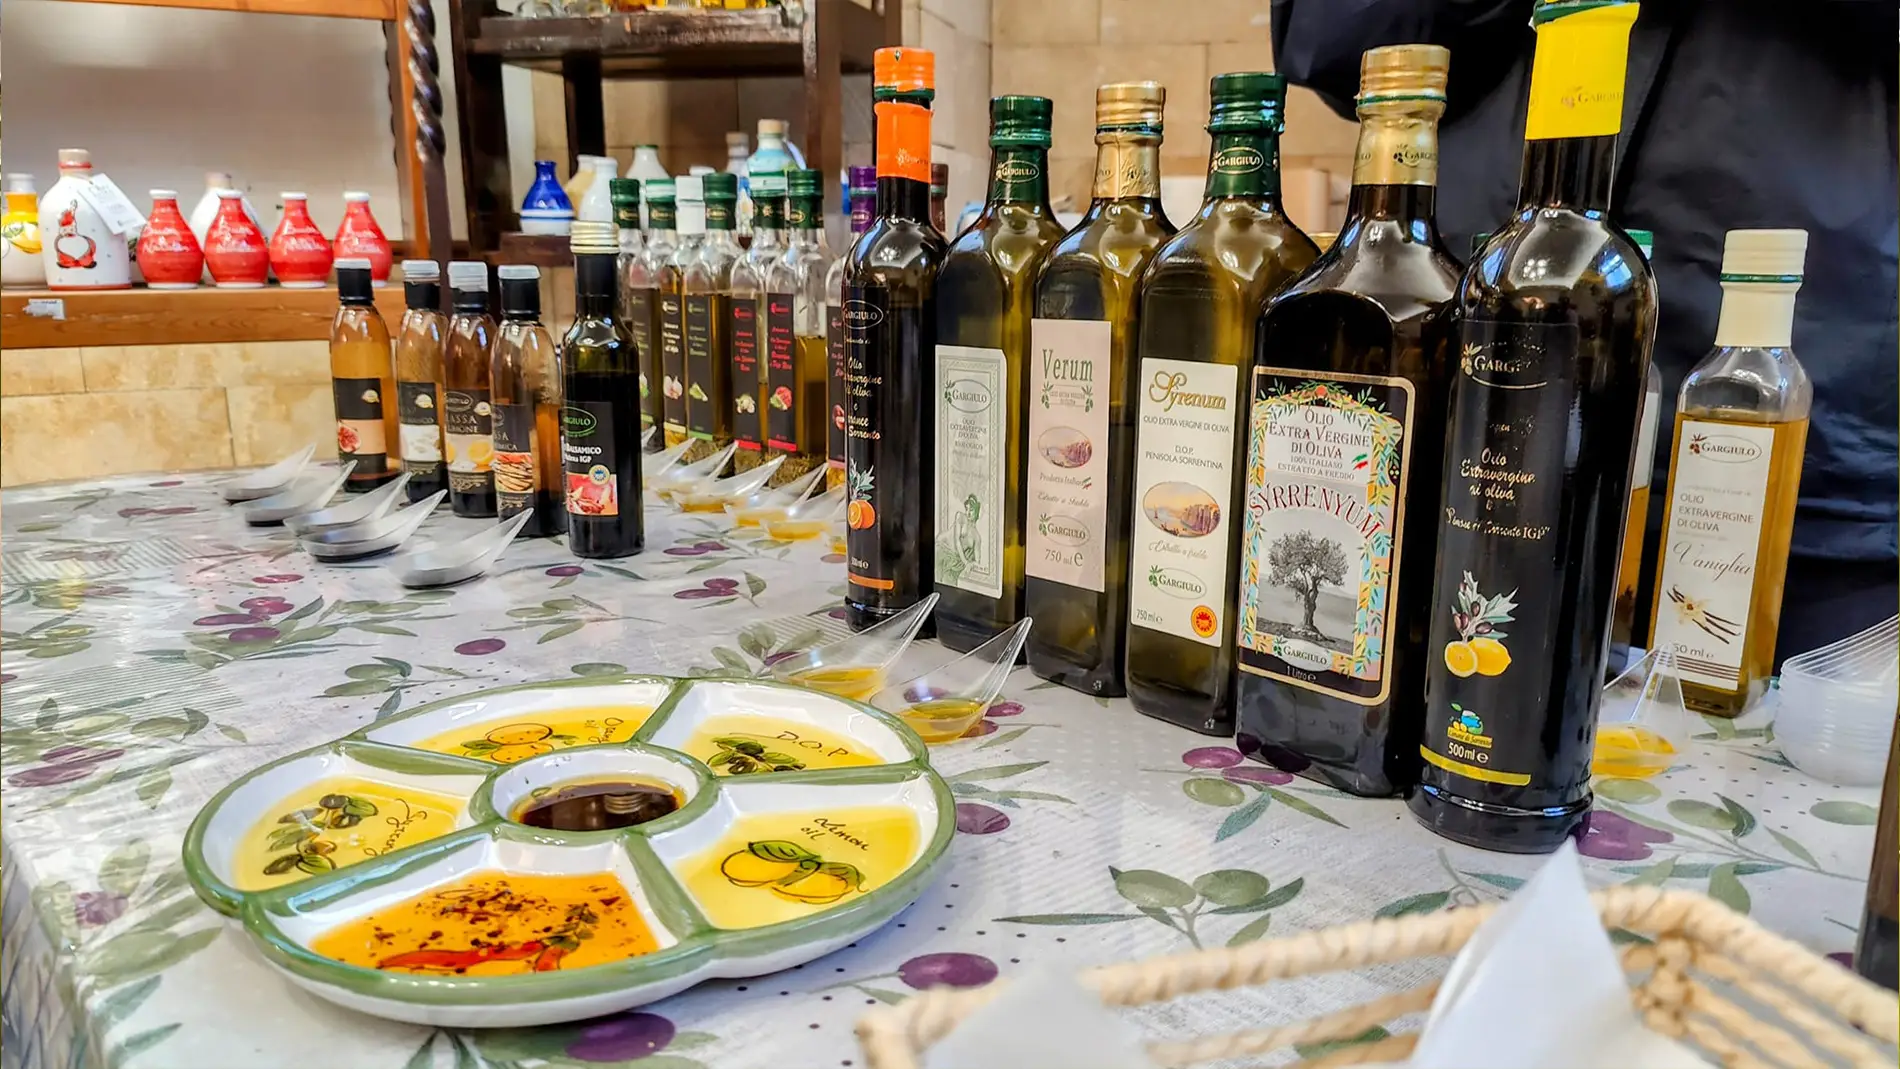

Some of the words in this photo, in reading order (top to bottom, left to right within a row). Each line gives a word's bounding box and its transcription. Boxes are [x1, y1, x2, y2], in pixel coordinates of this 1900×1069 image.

[1001, 166, 1037, 177] GARGIULO
[1042, 348, 1093, 382] Verum
[952, 389, 988, 404] GARGIULO
[1148, 370, 1228, 413] Syrenum
[1143, 414, 1159, 425] OLIO
[1159, 416, 1179, 428] EXTRA
[1178, 419, 1203, 431] VERGINE
[1203, 422, 1211, 431] DI
[1211, 422, 1231, 434] OLIVA
[1304, 408, 1334, 427] OLIO
[1268, 421, 1312, 441] EXTRA
[1315, 424, 1371, 449] VERGINE
[1305, 441, 1343, 460] OLIVA
[1701, 442, 1756, 457] GARGIULO
[1144, 450, 1179, 464] PENISOLA
[1179, 455, 1224, 471] SORRENTINA
[1308, 457, 1344, 470] ITALIANO
[1277, 462, 1317, 476] ESTRATTO
[1325, 470, 1355, 482] FREDDO
[1485, 483, 1515, 501] oliva
[1680, 493, 1704, 504] OLIO
[1250, 481, 1382, 540] SYRRENYUM
[1678, 505, 1755, 524] EXTRAVERGINE
[1047, 523, 1086, 541] GARGIULO
[1677, 518, 1688, 528] DI
[1689, 519, 1720, 532] OLIVA
[1045, 548, 1062, 563] 750
[1672, 540, 1752, 582] Vaniglia
[1158, 574, 1203, 595] GARGIULO
[1136, 609, 1148, 622] 750
[1283, 645, 1328, 666] GARGIULO
[1690, 648, 1705, 659] ml
[1448, 741, 1465, 759] 500
[1464, 748, 1475, 760] ml
[800, 826, 826, 842] oil
